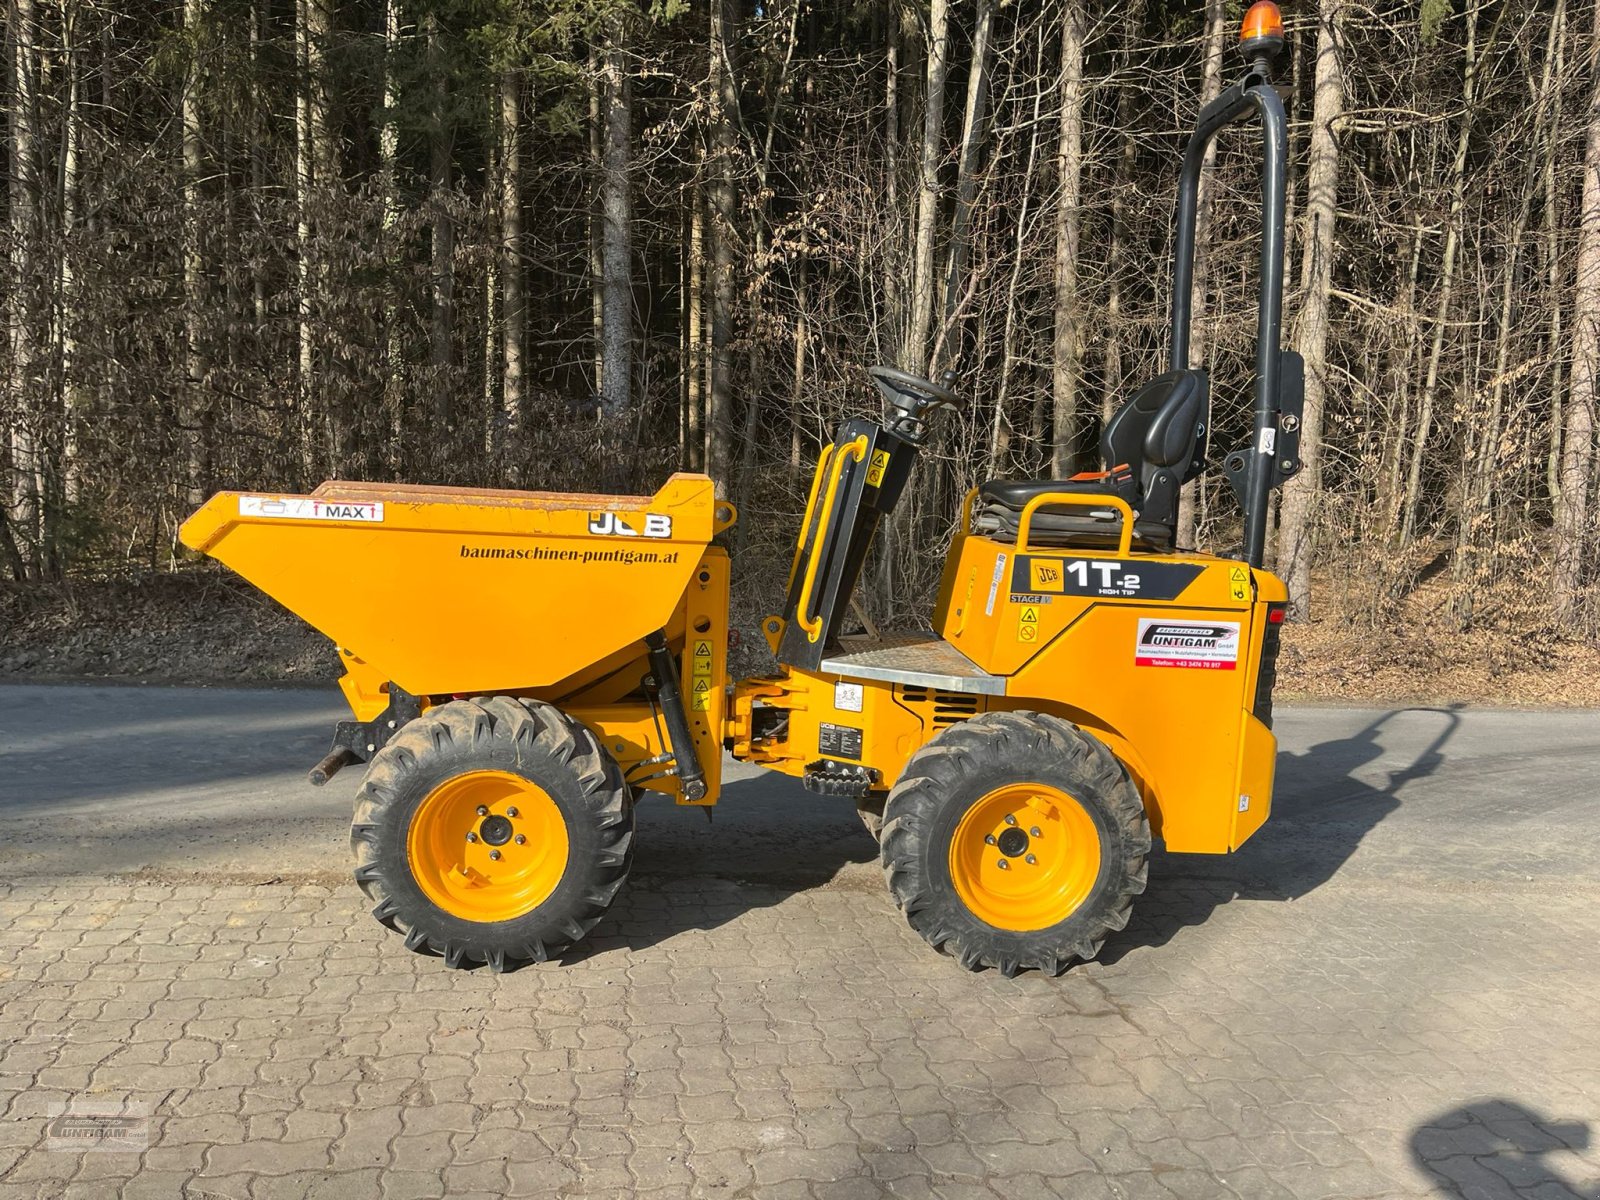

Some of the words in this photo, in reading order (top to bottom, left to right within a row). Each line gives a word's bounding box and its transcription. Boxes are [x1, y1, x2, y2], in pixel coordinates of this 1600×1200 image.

[326, 506, 365, 519] MAX
[460, 545, 679, 565] baumaschinen-puntigam.at
[1039, 567, 1059, 583] JCB
[1011, 595, 1040, 603] STAGE
